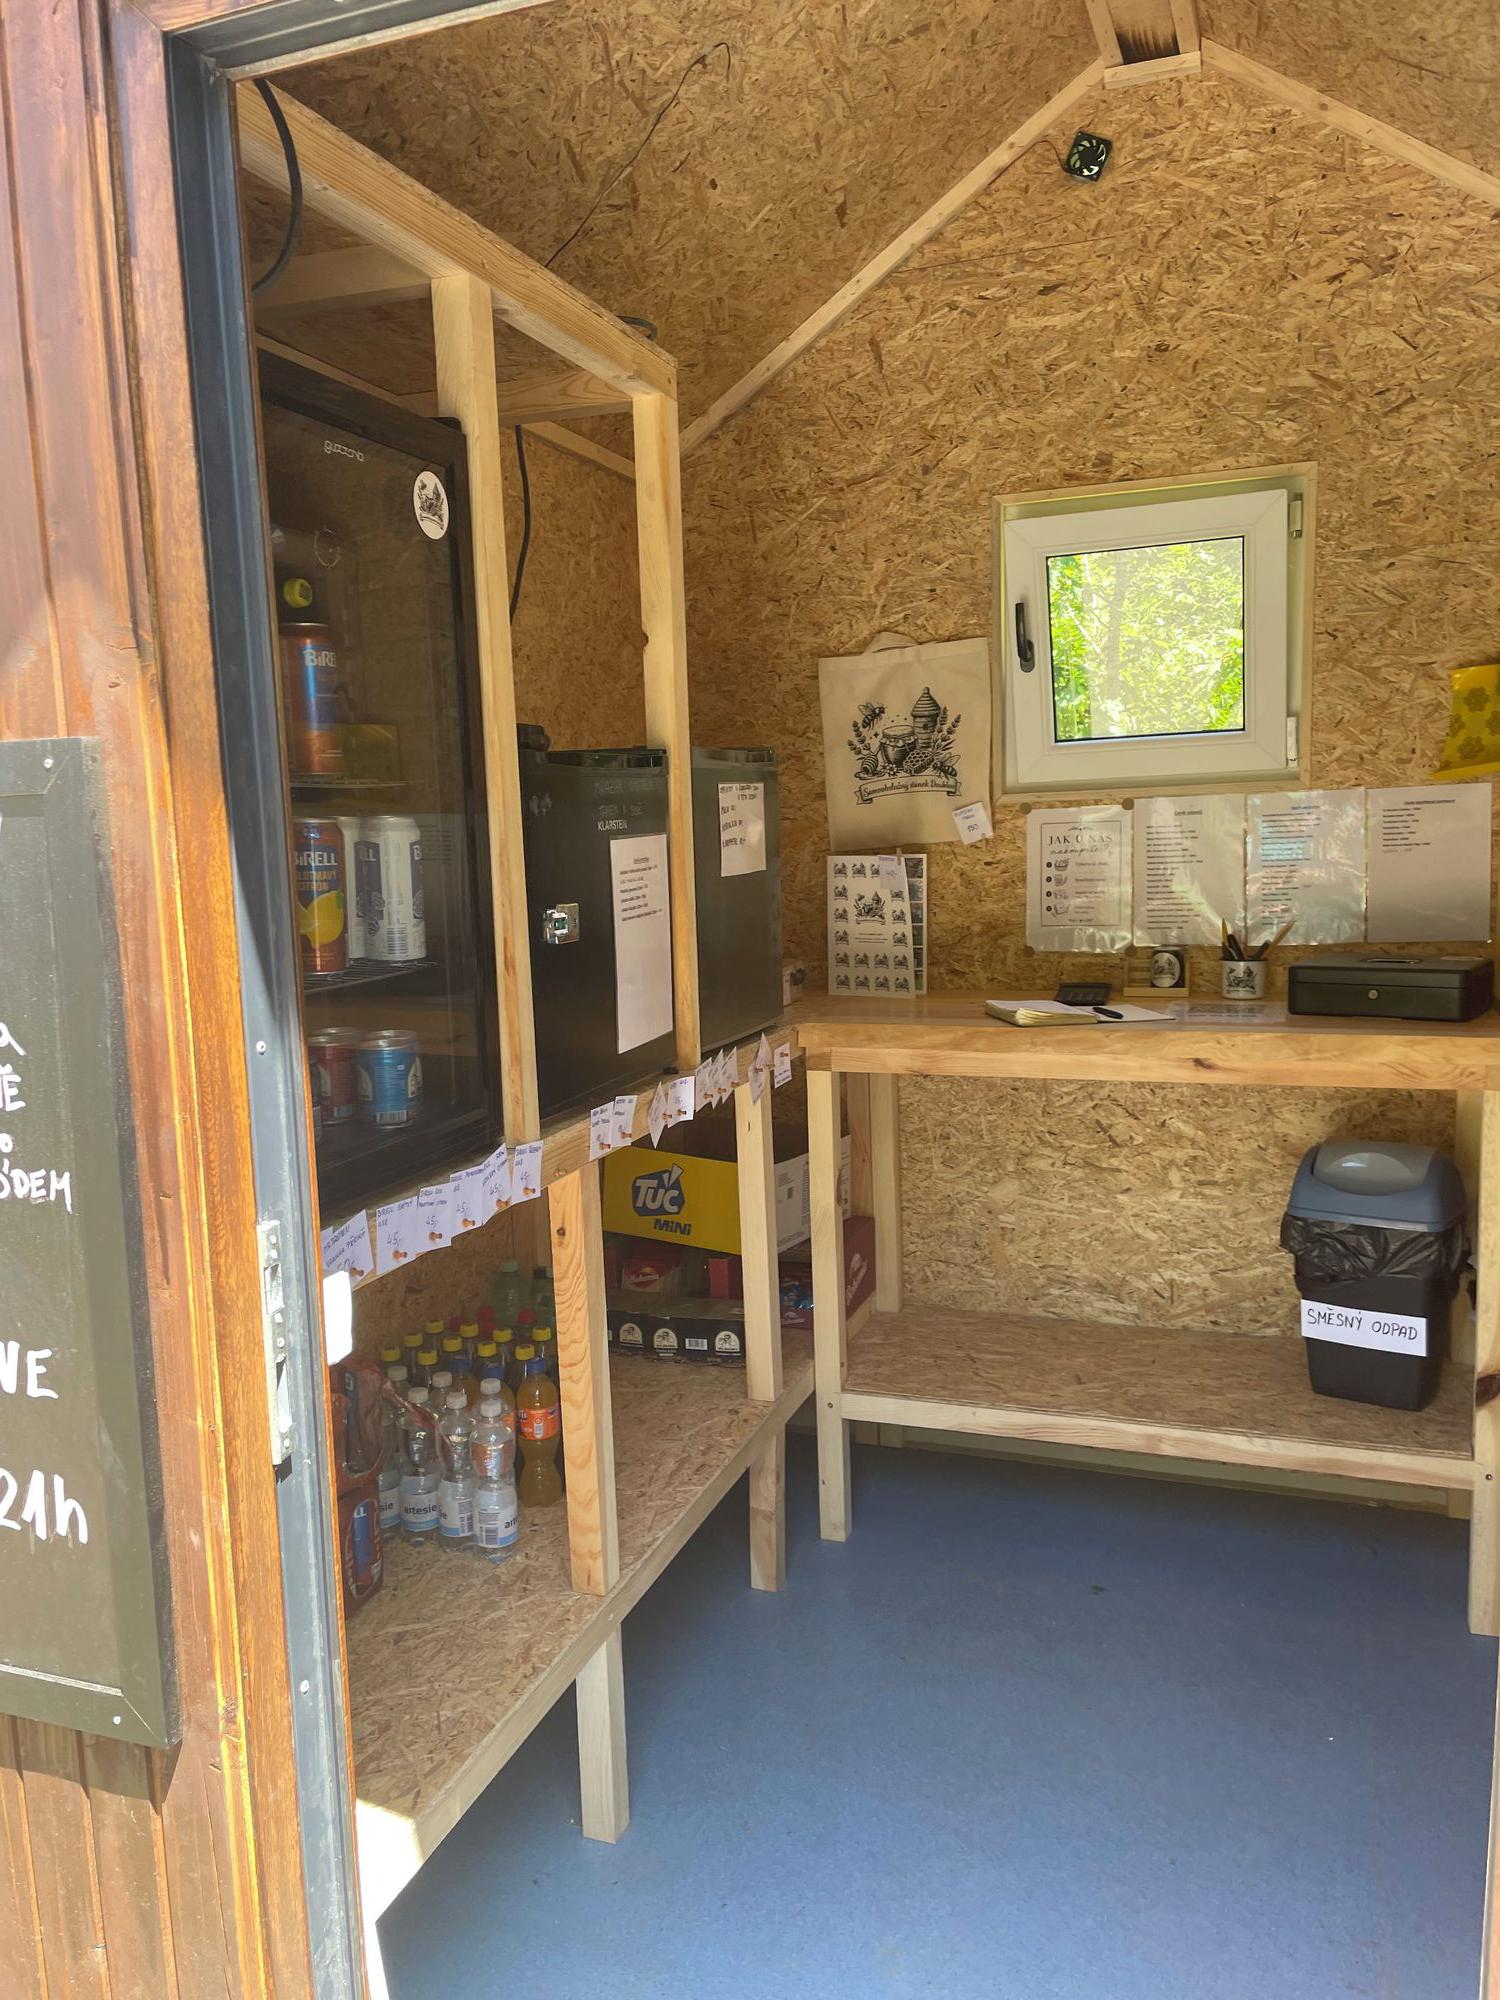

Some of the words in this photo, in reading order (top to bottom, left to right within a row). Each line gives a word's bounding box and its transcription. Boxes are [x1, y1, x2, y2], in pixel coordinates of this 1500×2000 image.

[1049, 834, 1070, 845] JAK
[1307, 1307, 1363, 1331] SMĚSNÝ
[1371, 1321, 1418, 1341] ODPAD
